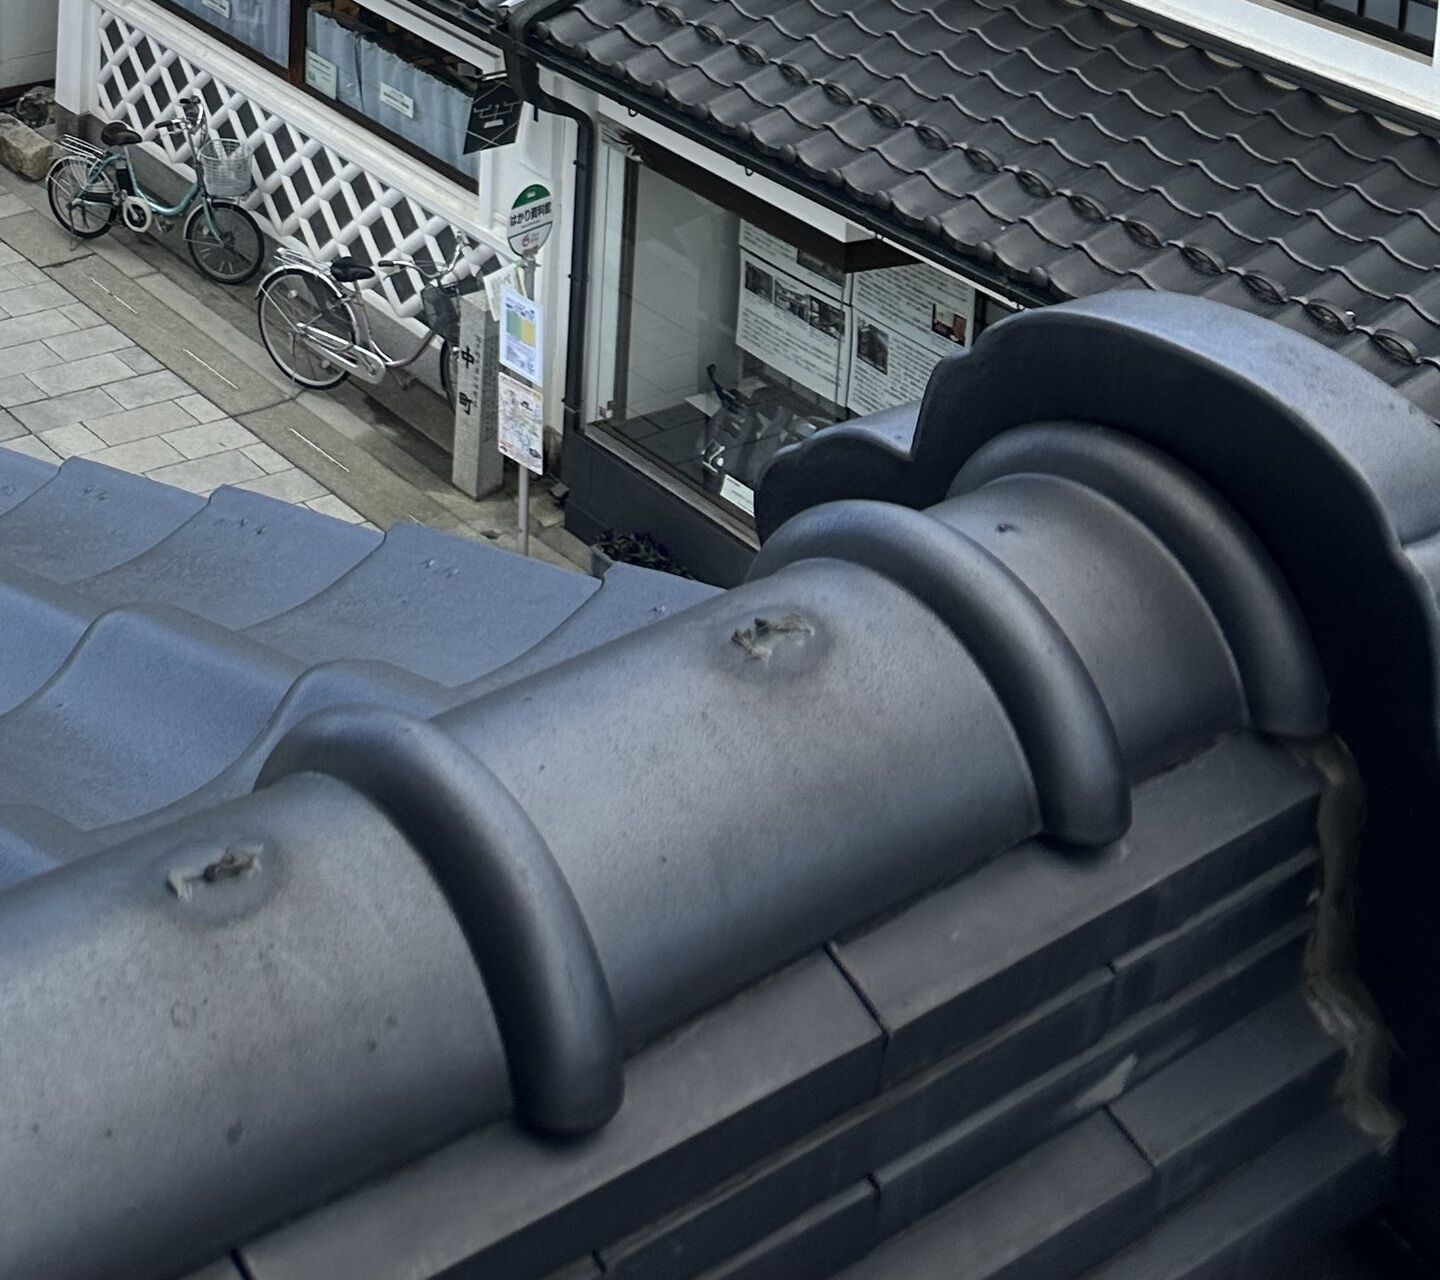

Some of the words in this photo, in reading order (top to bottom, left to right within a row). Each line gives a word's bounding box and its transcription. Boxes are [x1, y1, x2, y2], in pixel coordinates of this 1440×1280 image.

[510, 201, 552, 227] はかり資料館
[459, 346, 475, 415] 中町
